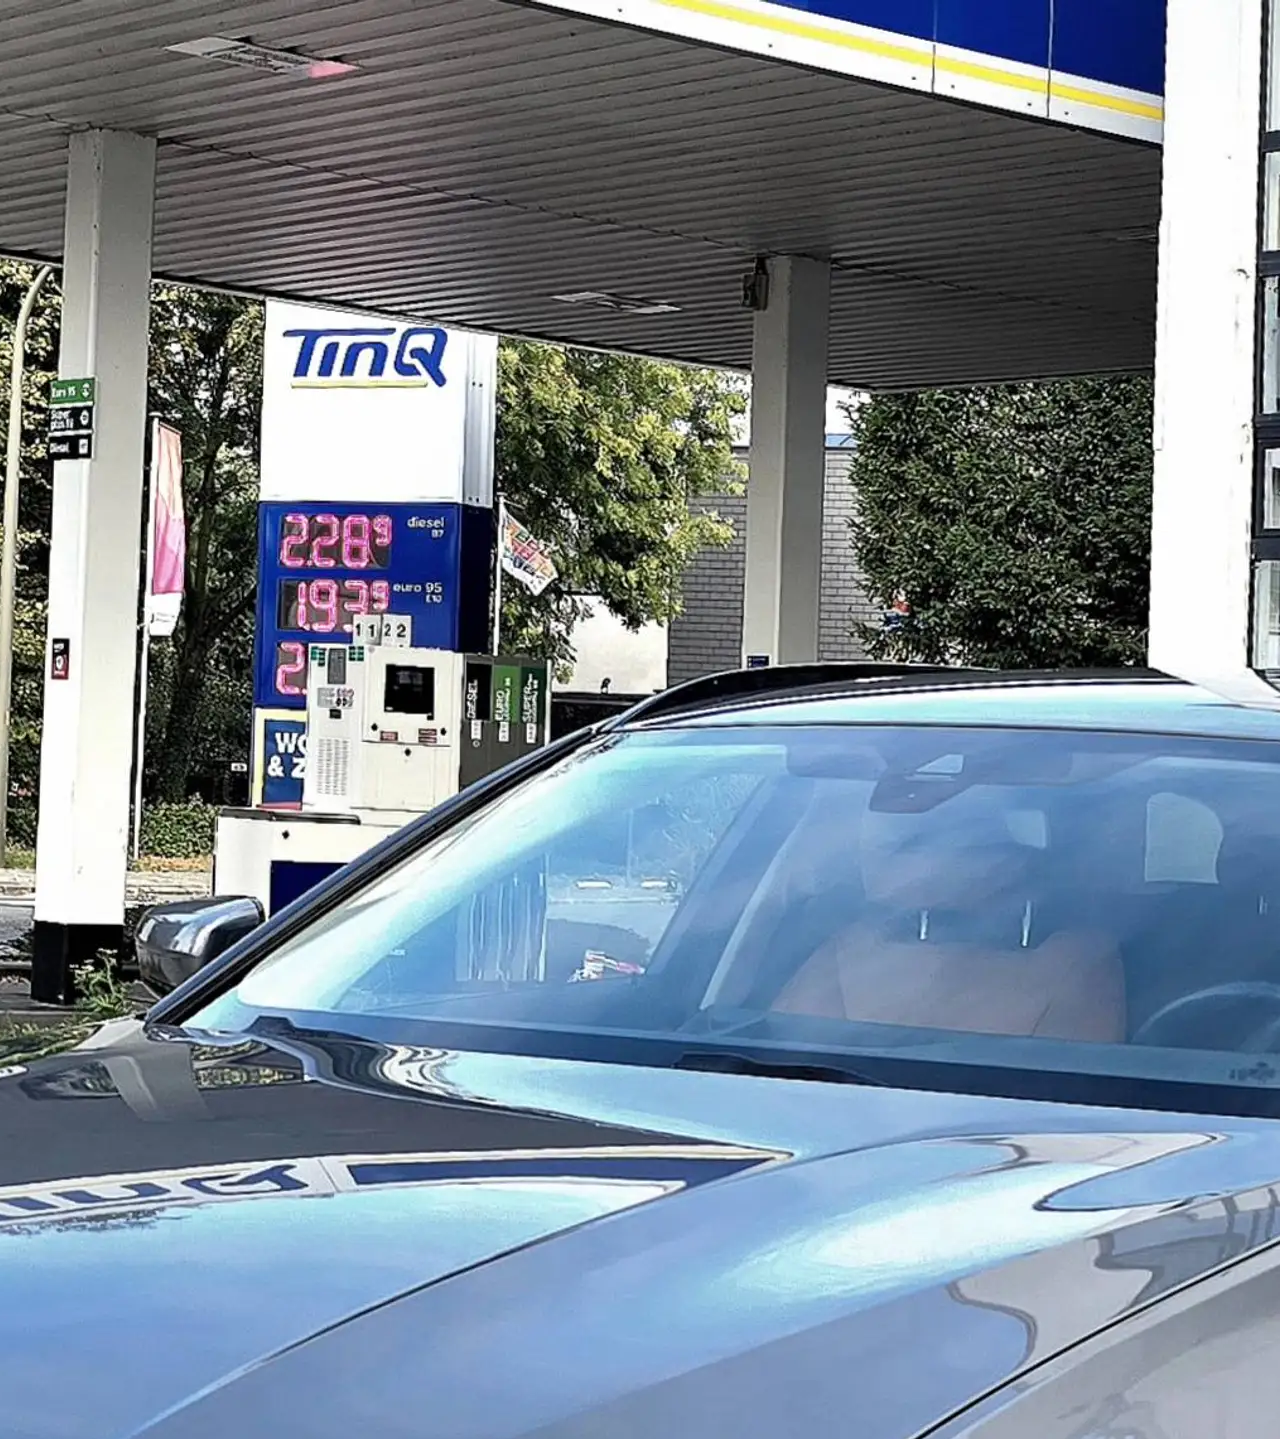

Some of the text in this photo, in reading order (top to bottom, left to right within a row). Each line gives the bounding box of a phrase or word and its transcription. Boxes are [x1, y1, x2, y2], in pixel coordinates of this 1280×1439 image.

[282, 327, 448, 388] TinQ
[407, 516, 445, 528] diesel
[393, 582, 443, 593] euro 95
